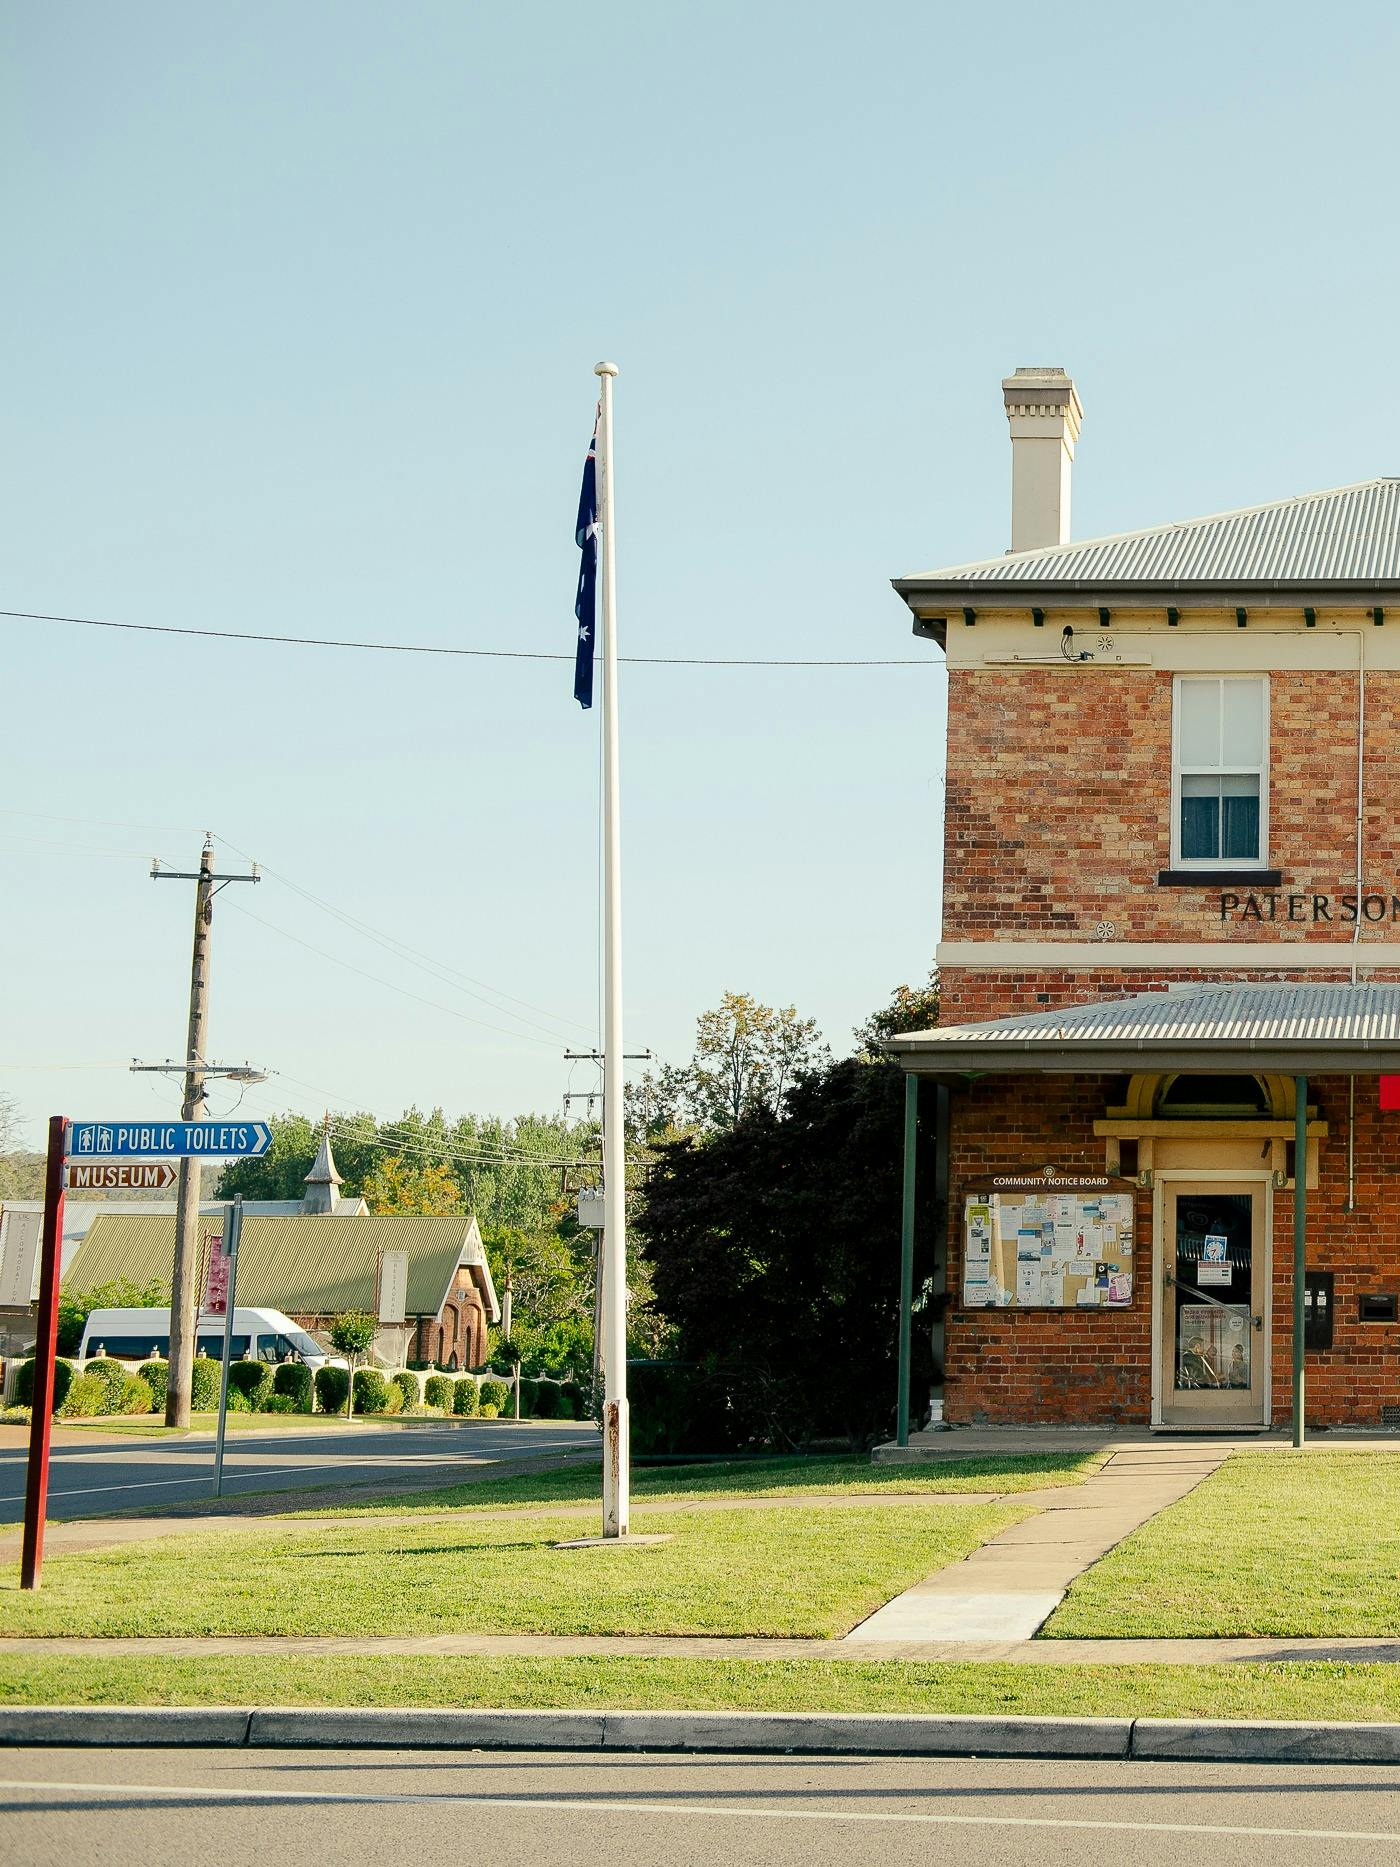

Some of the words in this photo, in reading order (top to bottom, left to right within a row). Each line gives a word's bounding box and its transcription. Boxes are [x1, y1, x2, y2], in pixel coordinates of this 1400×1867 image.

[117, 1127, 176, 1150] PUBLIC
[185, 1127, 248, 1150] TOILETS
[76, 1166, 159, 1188] MUSEUM
[993, 1177, 1046, 1186] COMMUNITY
[1048, 1177, 1078, 1186] NOTICE
[1079, 1177, 1109, 1186] BOARD
